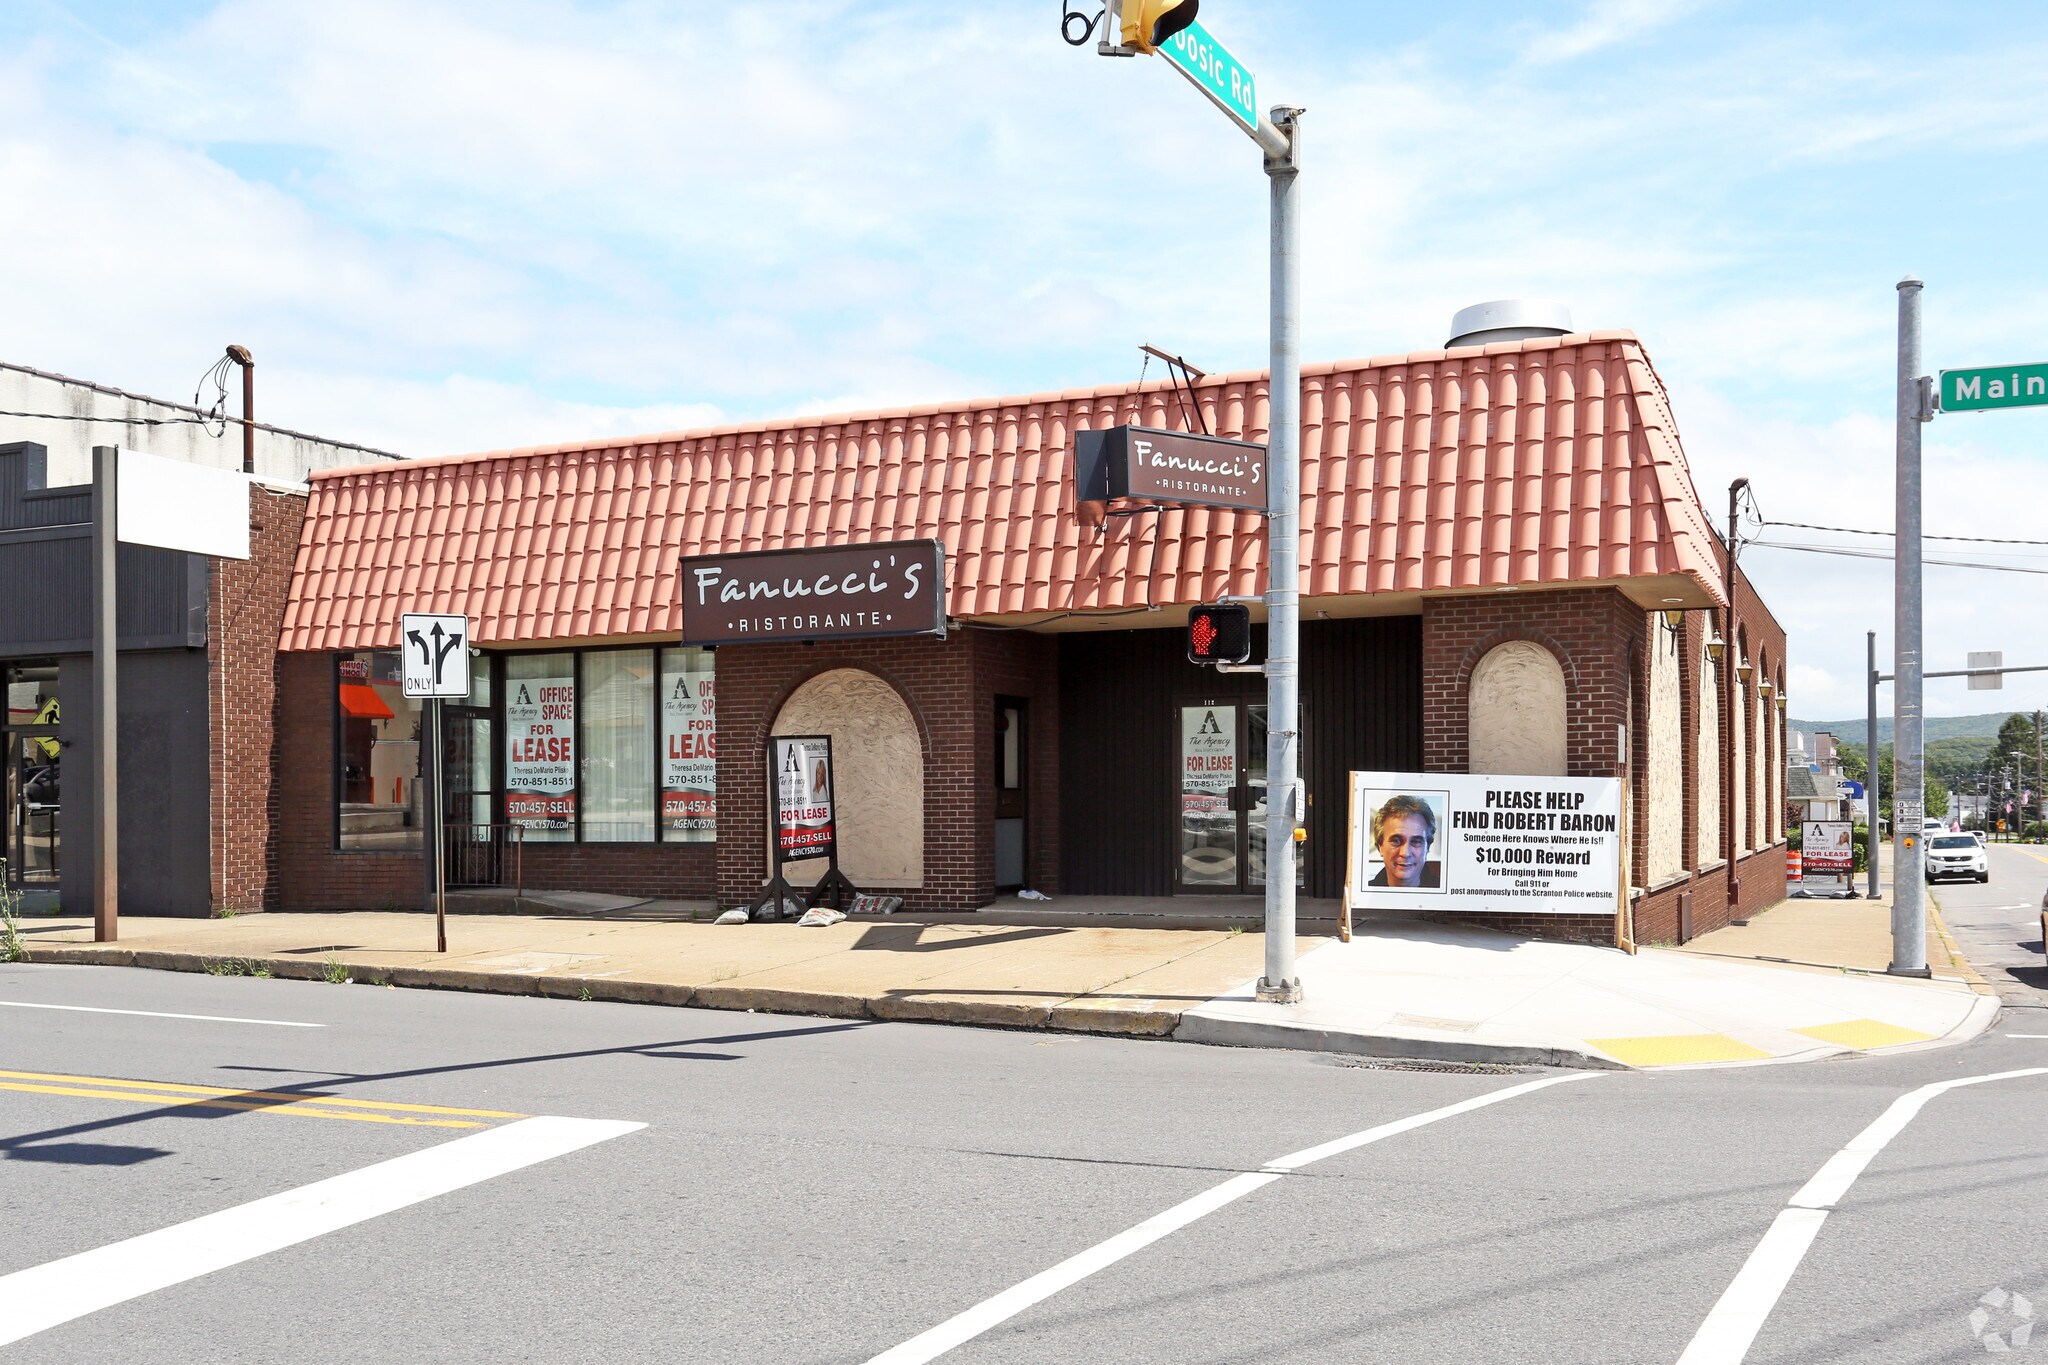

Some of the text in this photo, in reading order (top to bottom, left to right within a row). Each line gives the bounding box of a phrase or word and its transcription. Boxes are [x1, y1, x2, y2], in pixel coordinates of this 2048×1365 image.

[1168, 28, 1253, 112] oosic Rd
[1956, 373, 2046, 401] Main
[1134, 440, 1261, 484] Fanucci's
[1162, 478, 1241, 497] RISTORANTE
[693, 555, 923, 606] Fanucci's
[739, 611, 881, 632] RISTORANTE
[407, 678, 432, 690] ONLY
[539, 686, 573, 703] OFFICE
[520, 706, 538, 717] Agency
[542, 704, 572, 720] SPACE
[676, 702, 697, 712] Agency
[530, 725, 554, 735] FOR
[688, 720, 713, 731] FOR
[669, 734, 716, 760] LEAS
[1189, 736, 1230, 747] The Agency
[512, 737, 571, 763] LEASE
[1187, 755, 1233, 771] FOR LEASE
[511, 777, 573, 786] 570-851-8511
[668, 775, 716, 784] 570-851-8
[788, 776, 805, 788] Aency
[1485, 790, 1585, 810] PLEASE HELP
[781, 808, 828, 821] FOR LEASE
[672, 818, 717, 829] AGENCY570.
[1453, 811, 1616, 832] FIND ROBERT BARON
[1463, 833, 1604, 845] Someone Here Knows Where He Is!!
[1475, 847, 1591, 865] $10,000 Reward
[1487, 867, 1578, 878] For Bringing Him Home
[1515, 880, 1529, 888] Call
[1529, 880, 1541, 888] 911
[1466, 888, 1511, 897] anonymously
[1532, 889, 1563, 898] Scranton
[1563, 890, 1585, 898] Police
